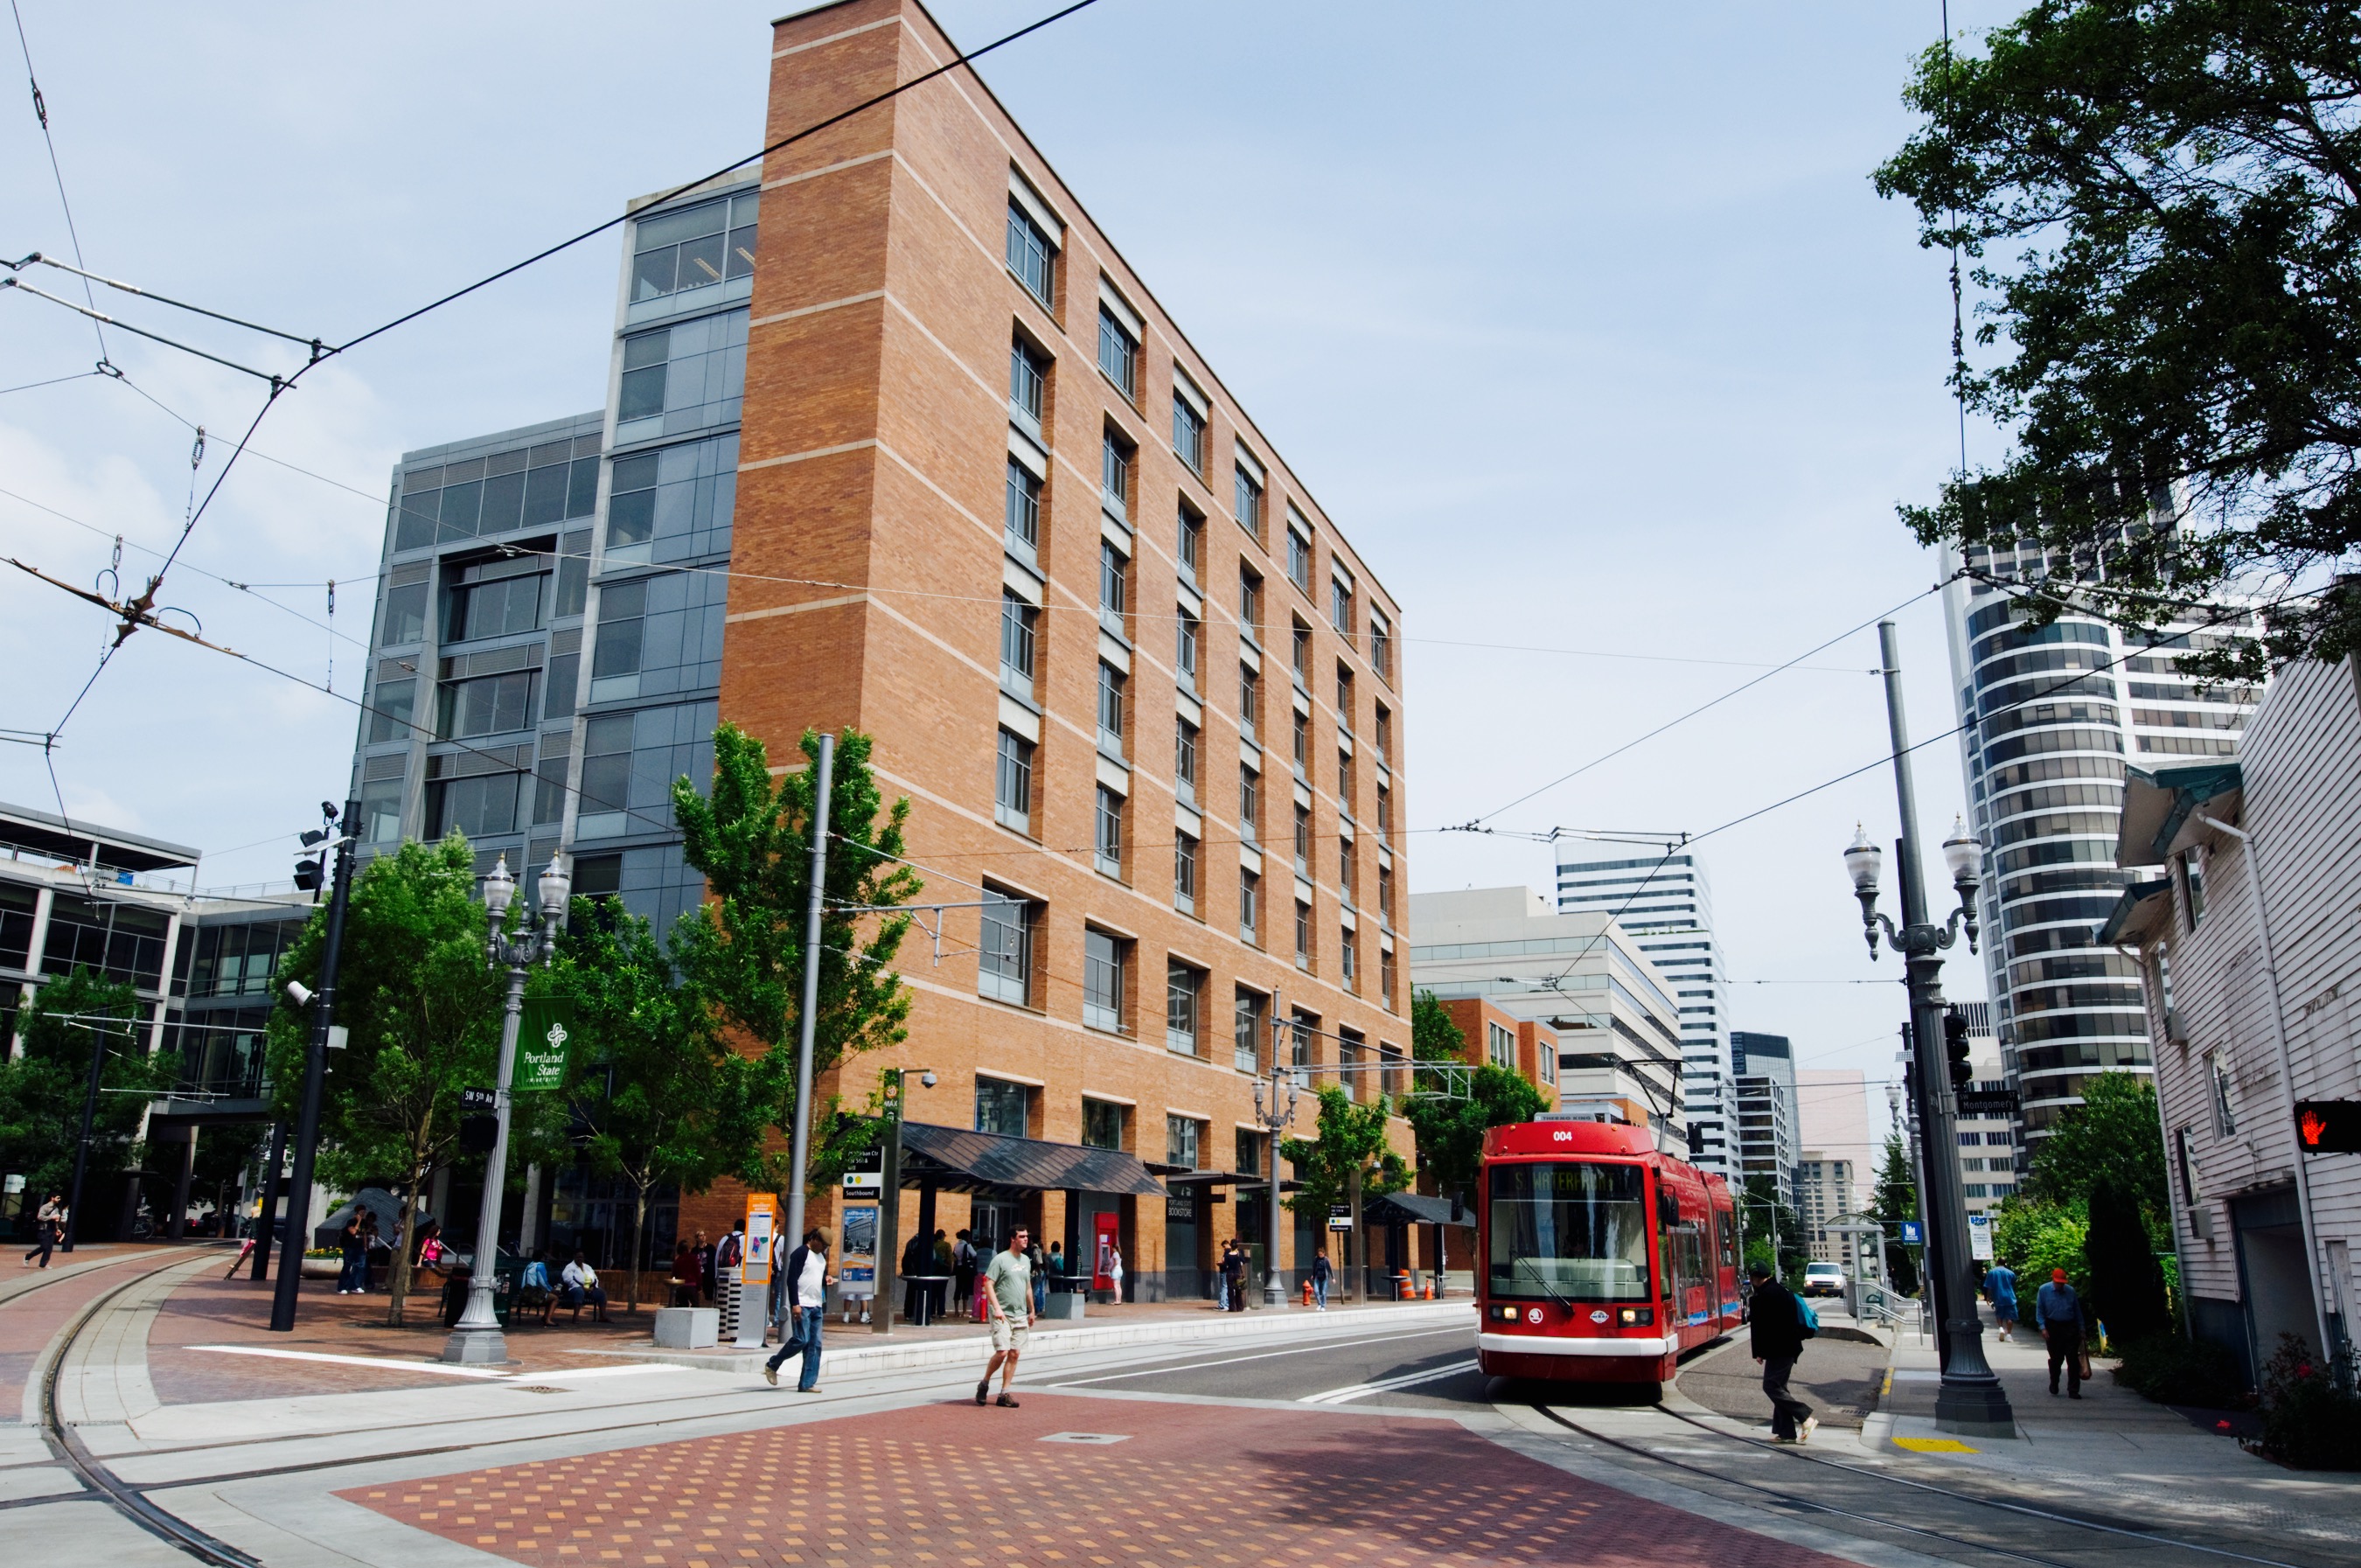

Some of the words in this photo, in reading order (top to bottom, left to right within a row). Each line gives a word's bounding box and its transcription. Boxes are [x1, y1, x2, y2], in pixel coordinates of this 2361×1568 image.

[524, 1051, 565, 1063] Portland
[537, 1064, 561, 1076] State
[464, 1090, 475, 1101] SW
[475, 1091, 484, 1102] 5th
[1963, 1099, 2014, 1111] Montgomery
[1553, 1131, 1572, 1141] 004
[1168, 1207, 1192, 1217] BOOKSTORE
